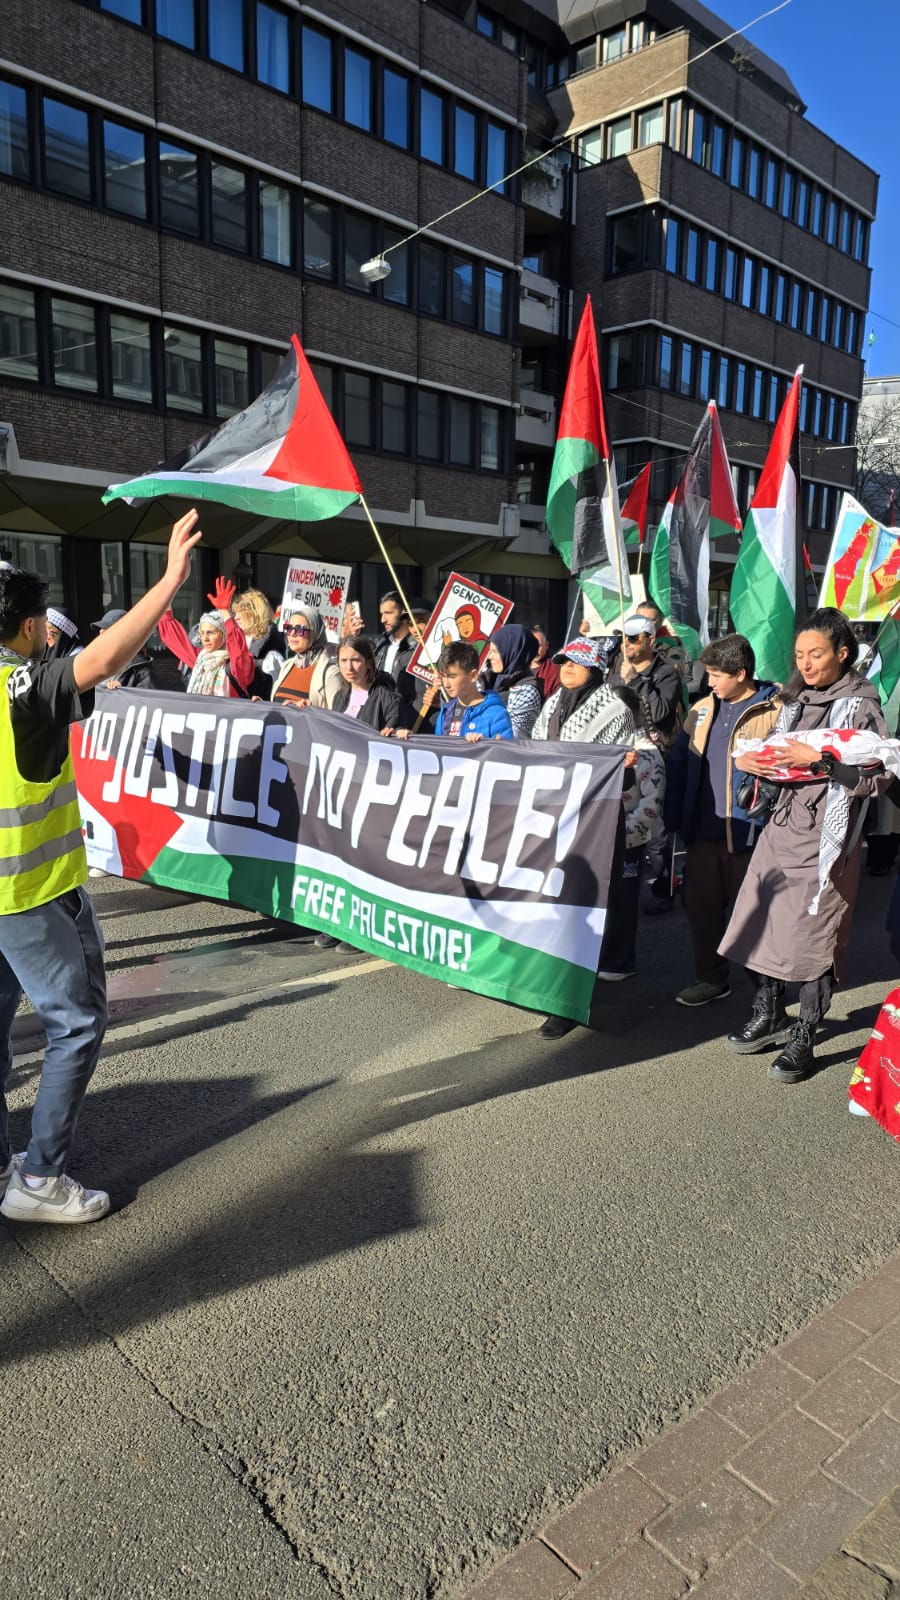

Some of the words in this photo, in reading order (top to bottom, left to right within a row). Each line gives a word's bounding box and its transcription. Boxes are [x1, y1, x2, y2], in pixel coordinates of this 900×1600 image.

[289, 568, 346, 591] KINDERMÖRDER
[304, 591, 322, 607] SIND
[453, 584, 502, 617] GENOCIDE
[102, 705, 293, 828] JUSTICE
[302, 742, 357, 829] NO
[351, 741, 593, 898] PEACE!
[290, 875, 347, 925] FREE
[349, 894, 472, 972] PALESTINE!
